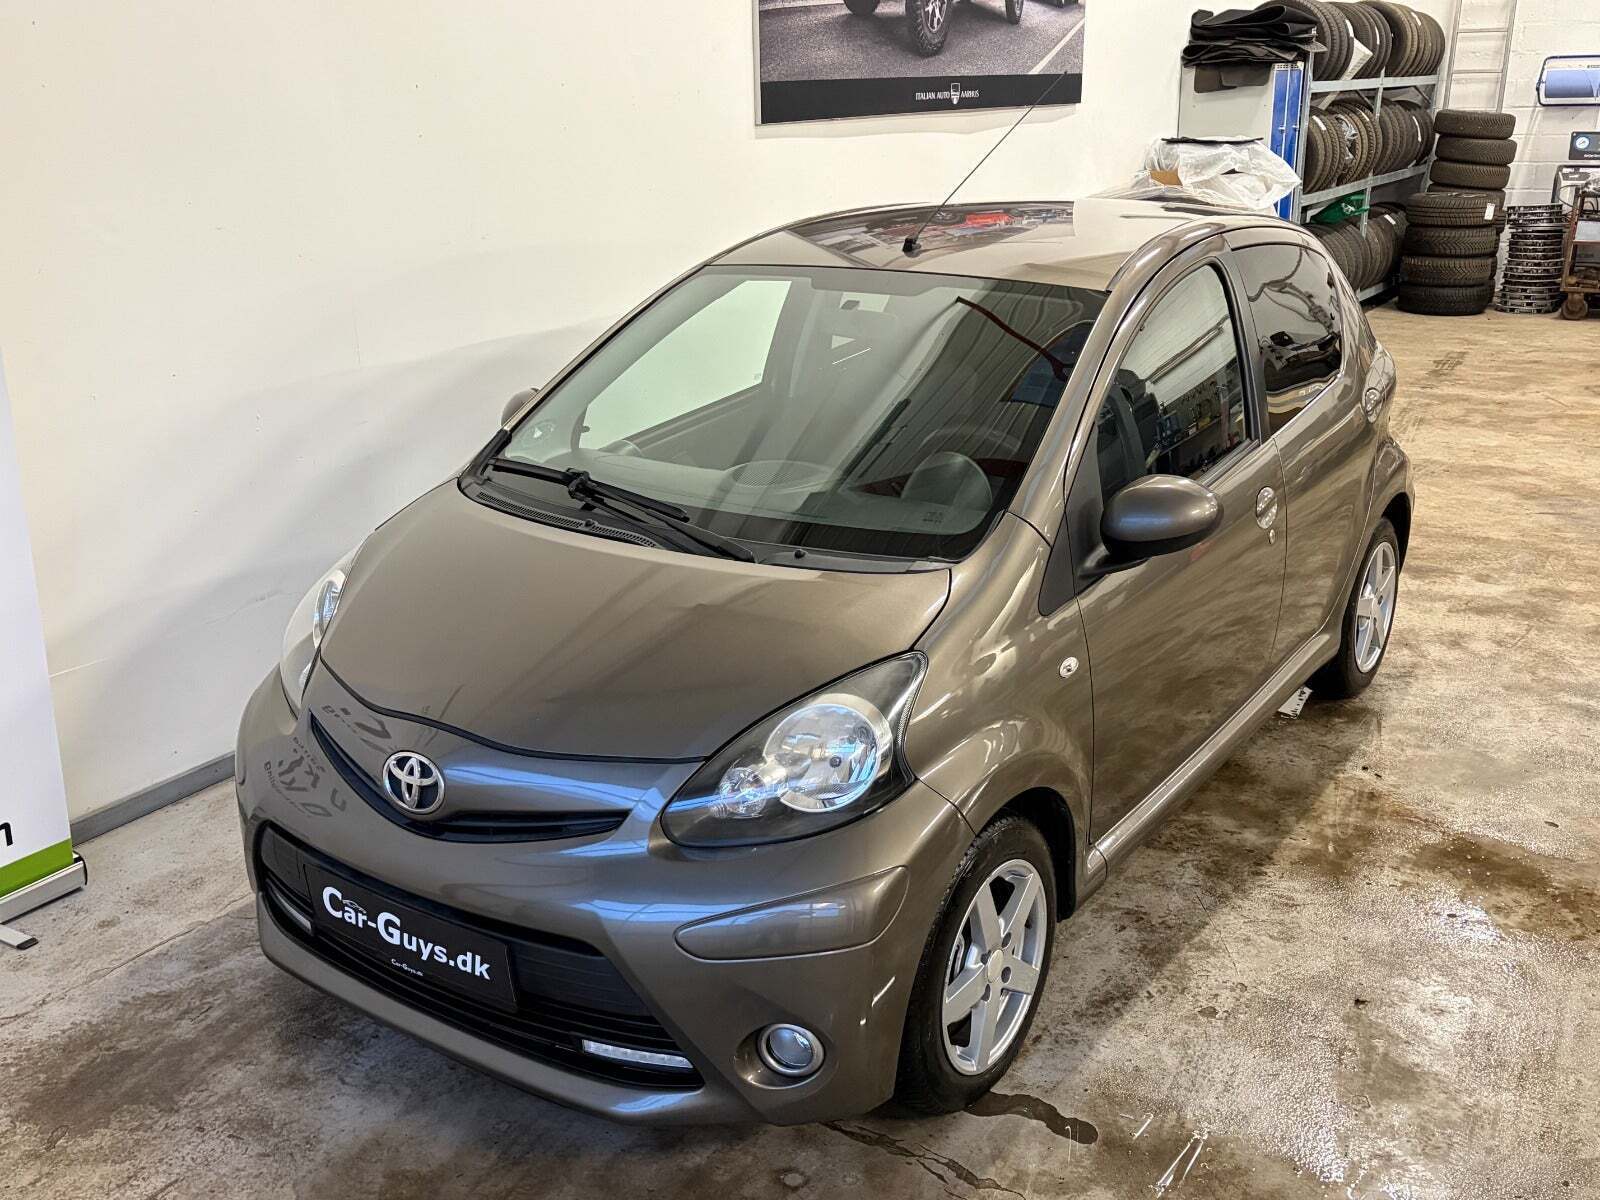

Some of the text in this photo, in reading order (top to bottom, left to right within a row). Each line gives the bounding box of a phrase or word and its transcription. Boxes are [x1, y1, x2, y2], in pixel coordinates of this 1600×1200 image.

[916, 92, 936, 100] ITALIAN
[936, 92, 950, 100] AUTO
[322, 886, 491, 980] Car-Guys.dk
